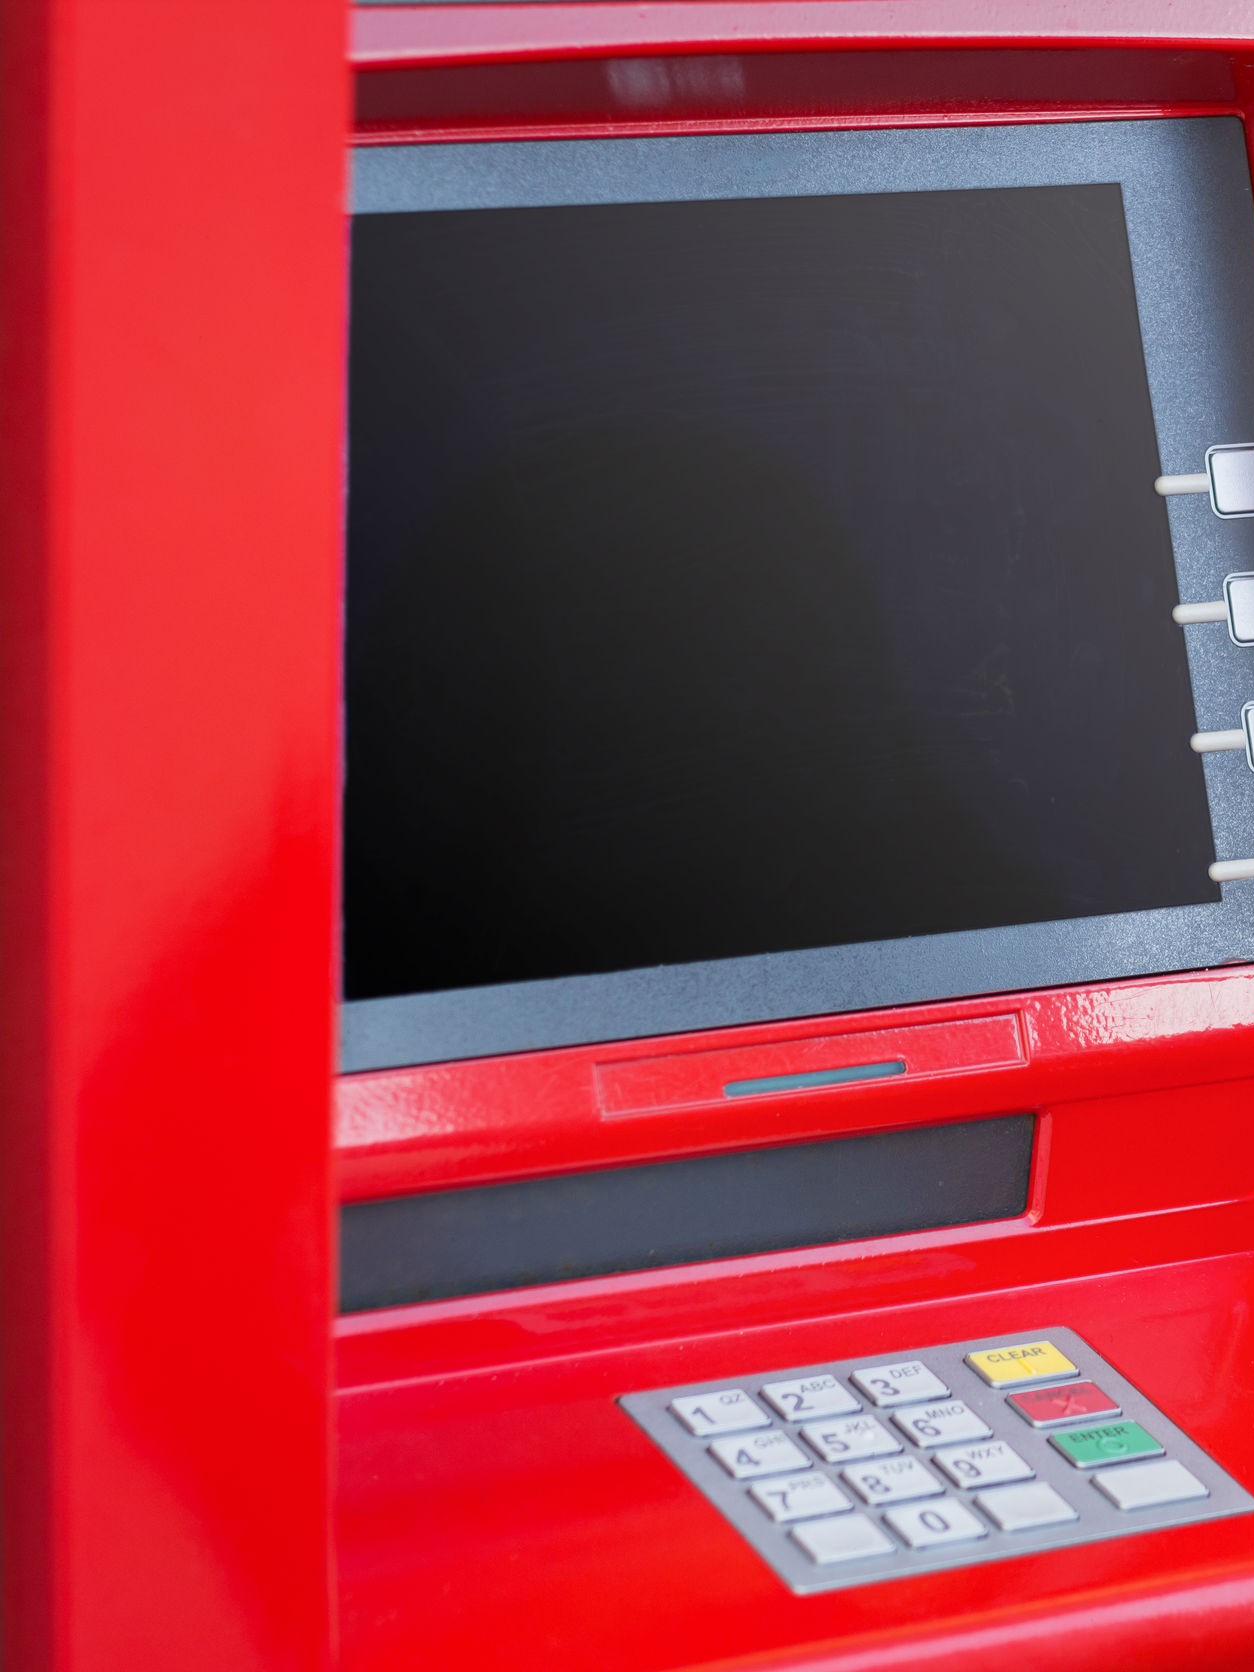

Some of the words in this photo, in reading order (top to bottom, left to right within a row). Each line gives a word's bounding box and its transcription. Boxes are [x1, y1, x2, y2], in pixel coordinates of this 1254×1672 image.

[986, 1346, 1047, 1364] CLEAR
[889, 1365, 923, 1380] DEF
[801, 1379, 836, 1393] ABC
[870, 1378, 901, 1396] 3
[781, 1392, 816, 1412] 2
[692, 1406, 716, 1424] 1
[924, 1404, 965, 1420] MNO
[912, 1419, 942, 1437] 6
[1068, 1425, 1129, 1444] ENTER
[821, 1433, 851, 1453] 5
[736, 1448, 761, 1466] 4
[953, 1459, 982, 1478] 9
[861, 1475, 892, 1494] 8
[766, 1491, 791, 1511] 7
